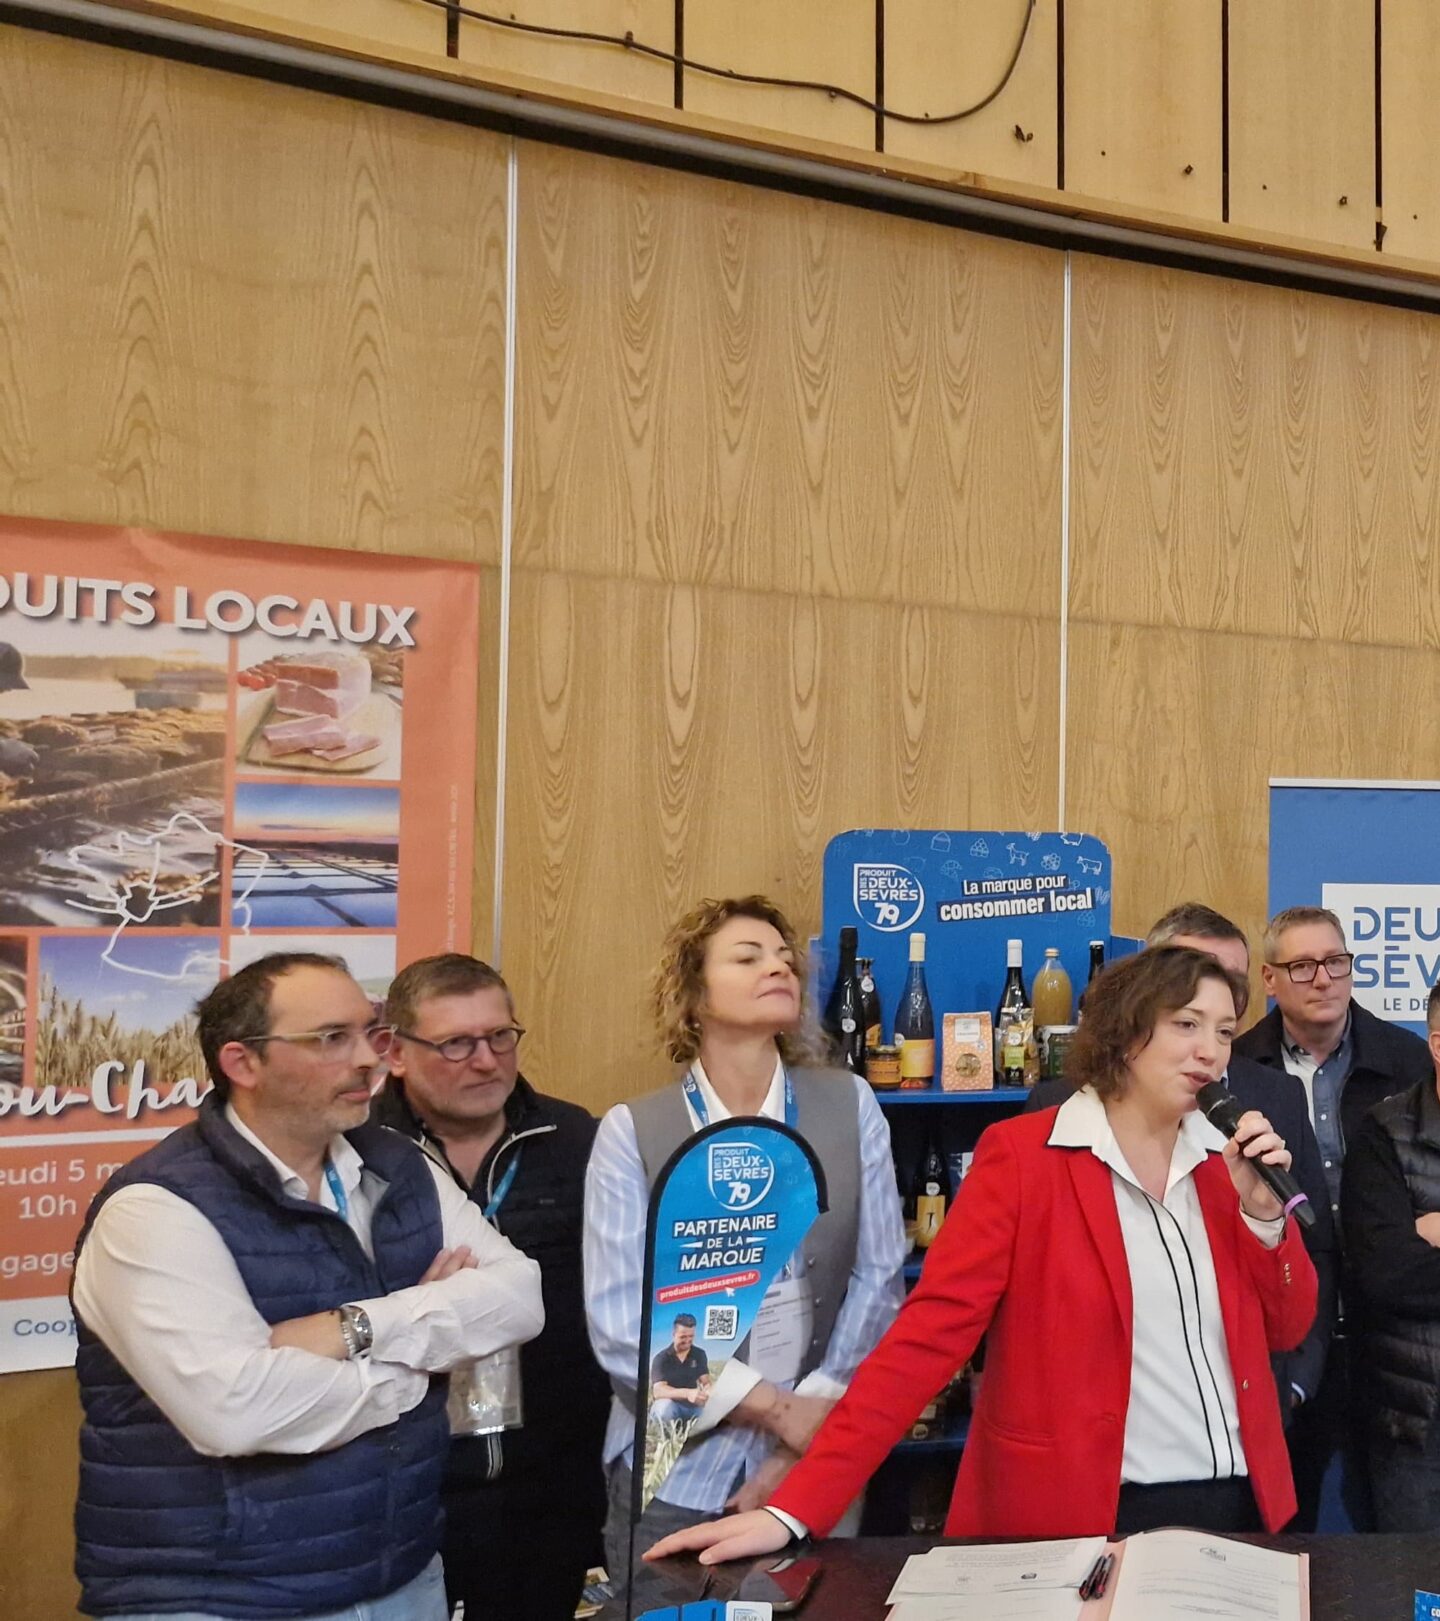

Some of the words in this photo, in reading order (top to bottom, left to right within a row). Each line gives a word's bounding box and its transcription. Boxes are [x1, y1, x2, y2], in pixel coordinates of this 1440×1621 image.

[0, 572, 156, 626] UITS
[174, 585, 416, 647] LOCAUX
[859, 869, 897, 877] PRODUIT
[869, 877, 913, 889] DEUX-
[963, 879, 979, 896] La
[982, 877, 1033, 896] marque
[1036, 875, 1067, 893] pour
[874, 902, 900, 925] 79
[940, 896, 1045, 921] consommer
[1049, 887, 1093, 912] local
[1383, 997, 1402, 1012] LE
[68, 1159, 86, 1182] 5
[728, 1181, 752, 1205] 79
[19, 1193, 77, 1219] 10h
[673, 1213, 777, 1237] PARTENAIRE
[706, 1237, 724, 1249] DE
[728, 1235, 744, 1247] LA
[680, 1247, 764, 1271] MARQUE
